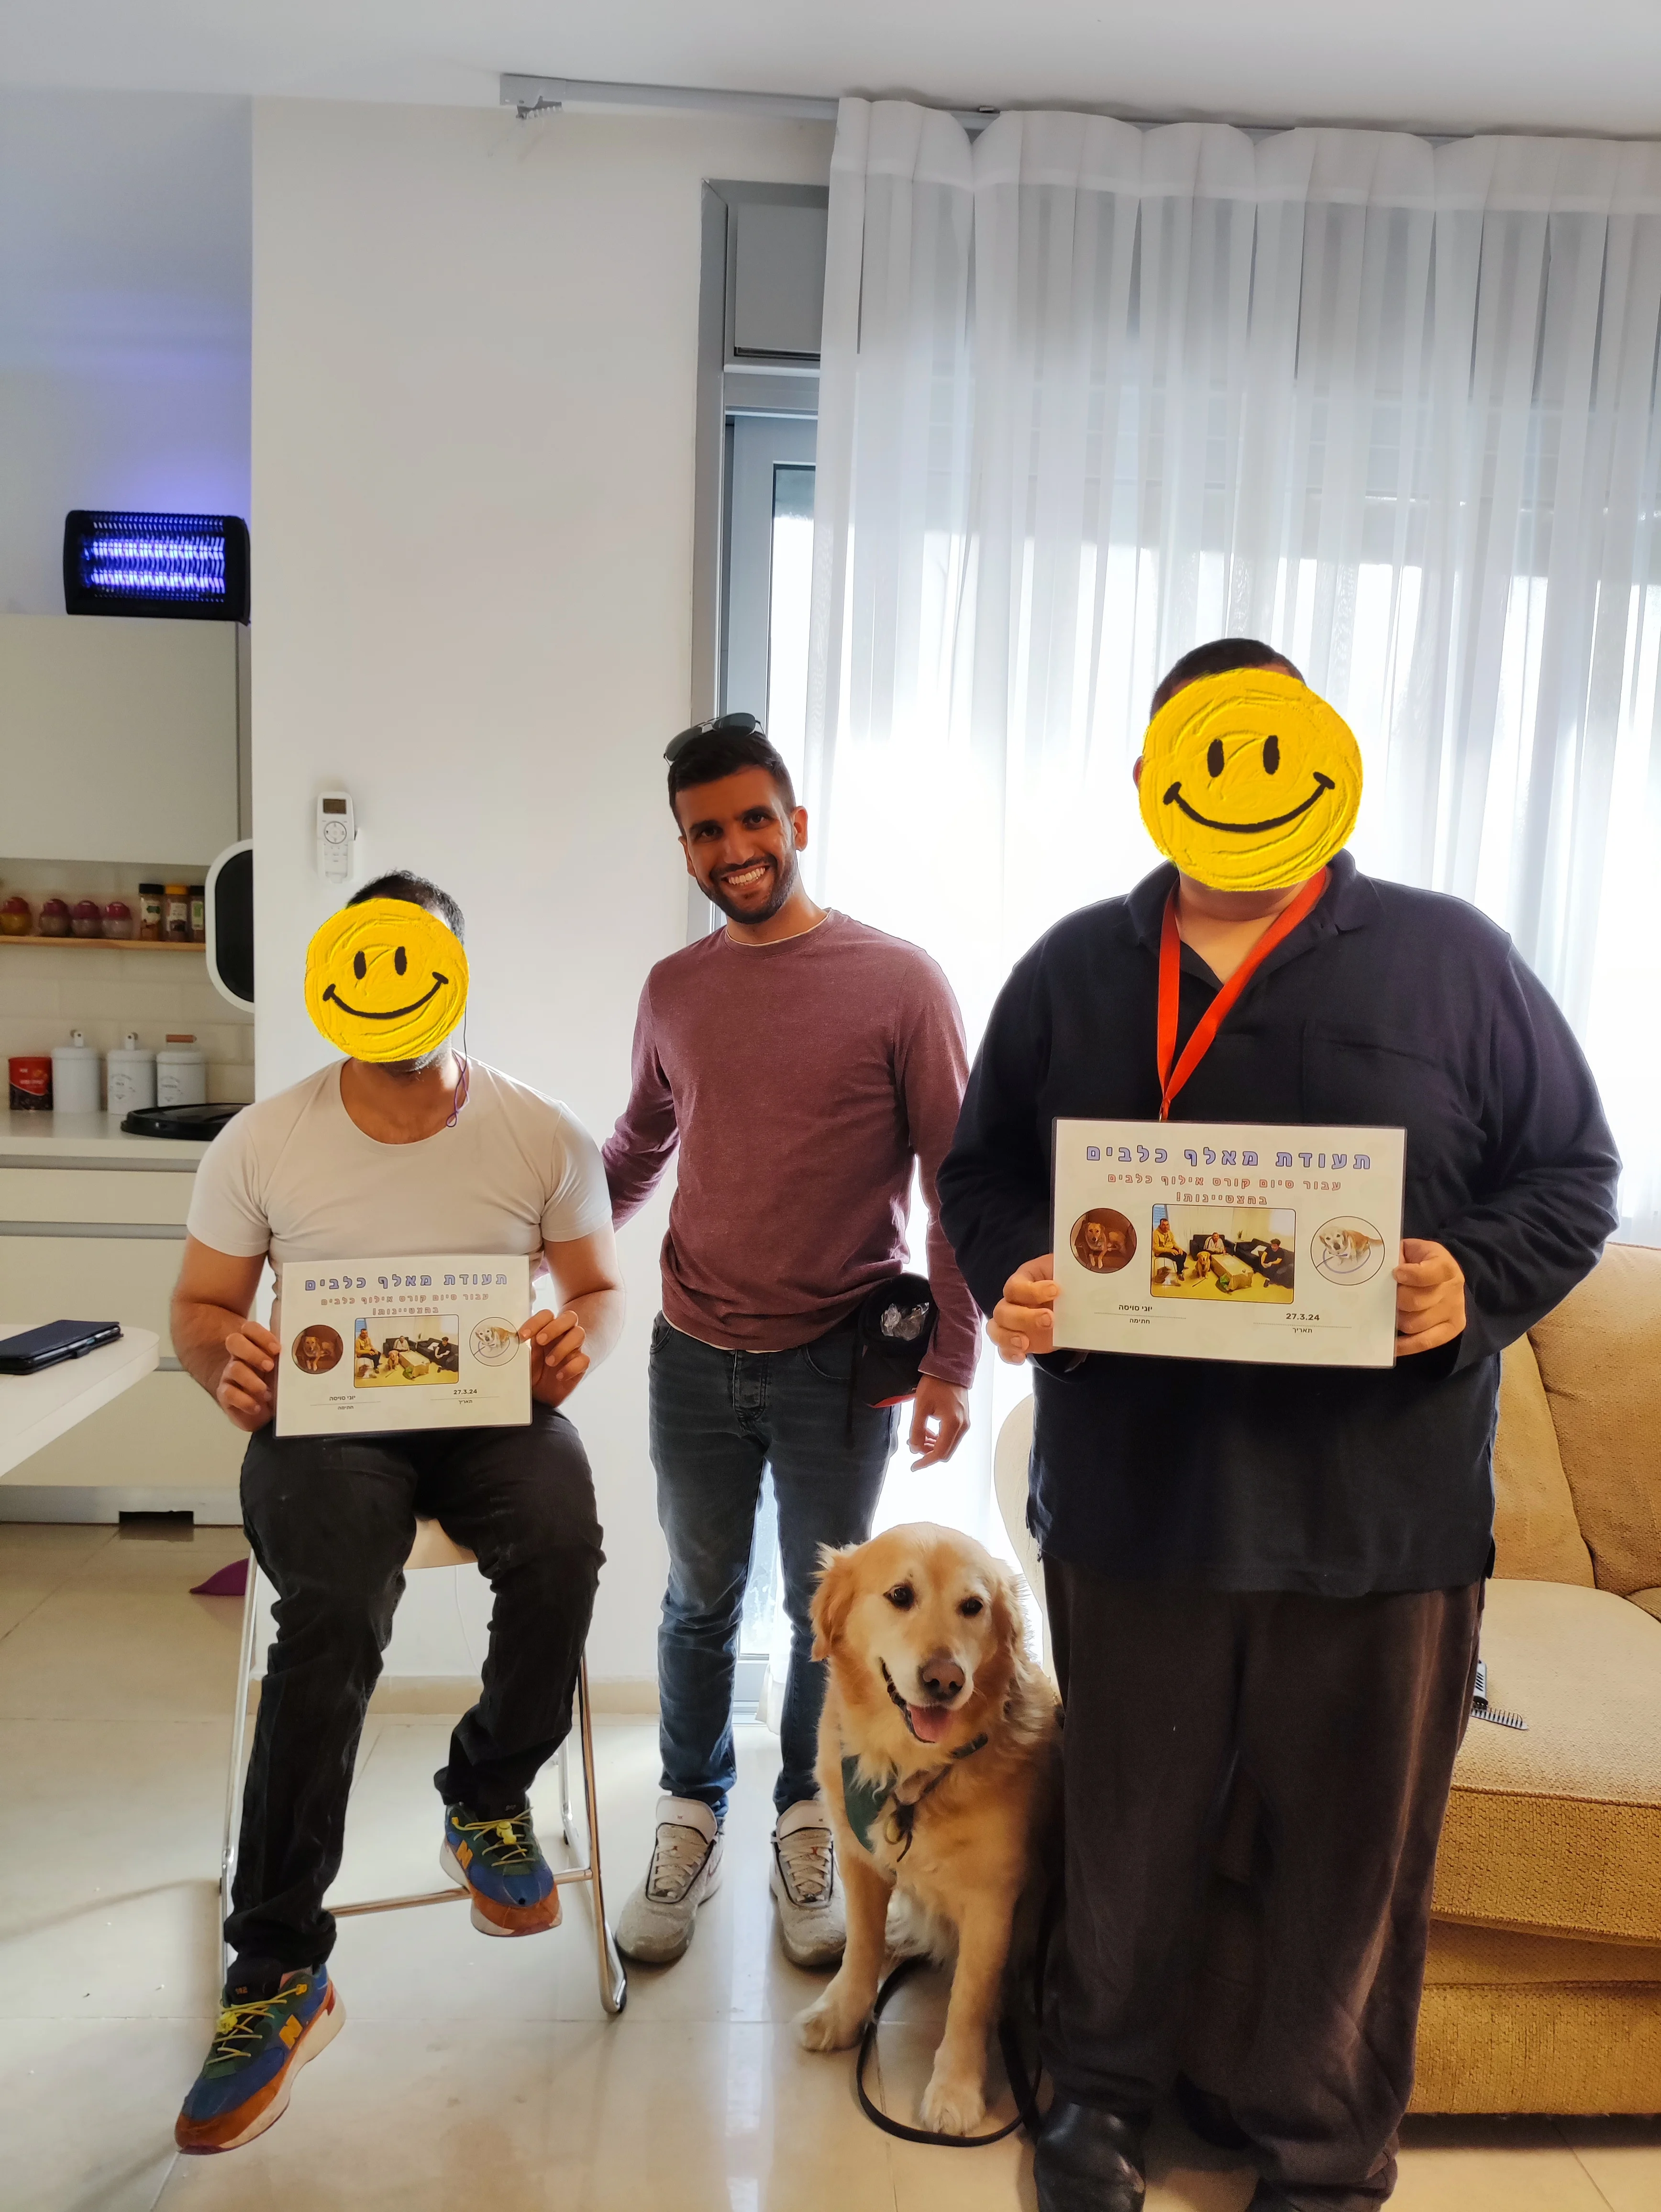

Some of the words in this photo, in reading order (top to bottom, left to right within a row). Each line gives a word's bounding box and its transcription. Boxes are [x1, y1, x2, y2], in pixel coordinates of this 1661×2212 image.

[1086, 1145, 1168, 1163] כלבים
[1184, 1147, 1258, 1167] מאלף
[1275, 1151, 1371, 1170] תעודת
[1107, 1173, 1152, 1183] כלבים
[1161, 1175, 1204, 1186] אילוף
[1212, 1177, 1251, 1189] קורס
[1259, 1179, 1294, 1189] סיום
[1303, 1180, 1341, 1191] עבור
[1176, 1192, 1267, 1205] בהצטיינות!
[305, 1276, 366, 1291] כלבים
[378, 1273, 432, 1289] מאלף
[443, 1274, 507, 1285] תעודת
[321, 1297, 355, 1305] כלבים
[361, 1295, 393, 1305] אילוף
[399, 1294, 427, 1303] קורס
[1285, 1313, 1320, 1321] 27.3.24
[278, 2014, 303, 2050] N
